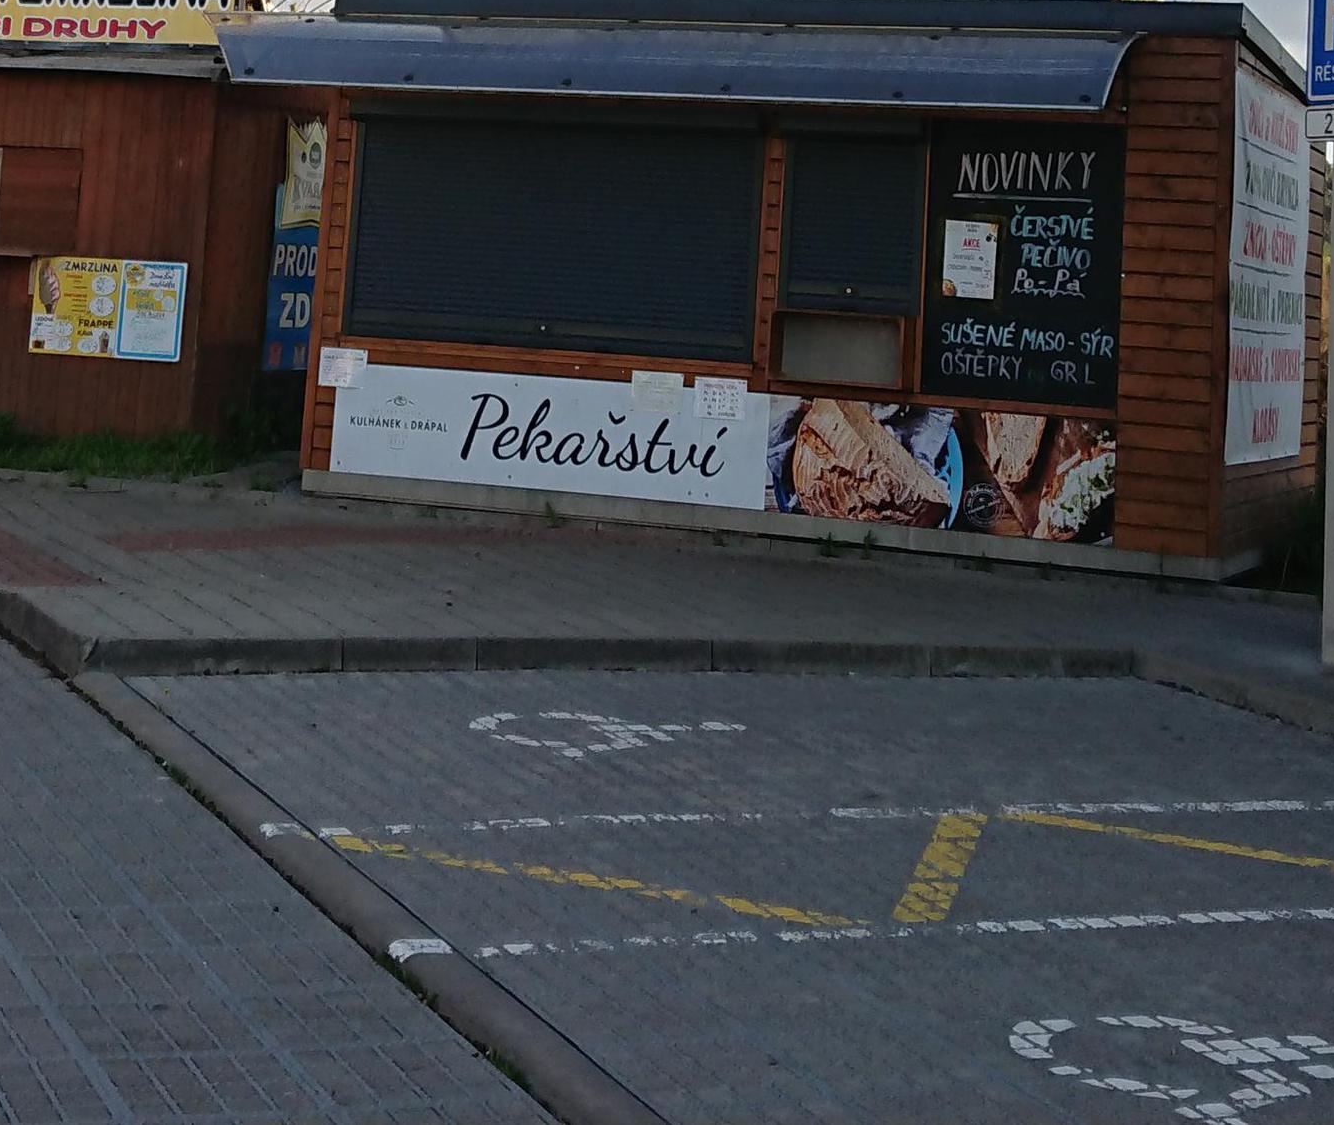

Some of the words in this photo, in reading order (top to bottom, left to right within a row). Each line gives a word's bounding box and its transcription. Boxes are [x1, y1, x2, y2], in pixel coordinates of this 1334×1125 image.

[22, 16, 166, 40] DRUHY
[957, 151, 1096, 192] NOVINKY
[1010, 205, 1094, 240] ČERSTVÉ
[963, 238, 980, 248] AKCE
[1020, 239, 1091, 270] PEČIVO
[65, 261, 118, 273] ZMRZLINA
[941, 318, 1016, 347] SUŠENÉ
[1020, 328, 1065, 351] MASO
[1080, 328, 1114, 358] SÝR
[941, 347, 1022, 380] OŠTĚPKY
[350, 415, 401, 429] KULHÁNEK
[410, 419, 448, 432] DRÁPAL
[460, 392, 728, 478] Pekařství
